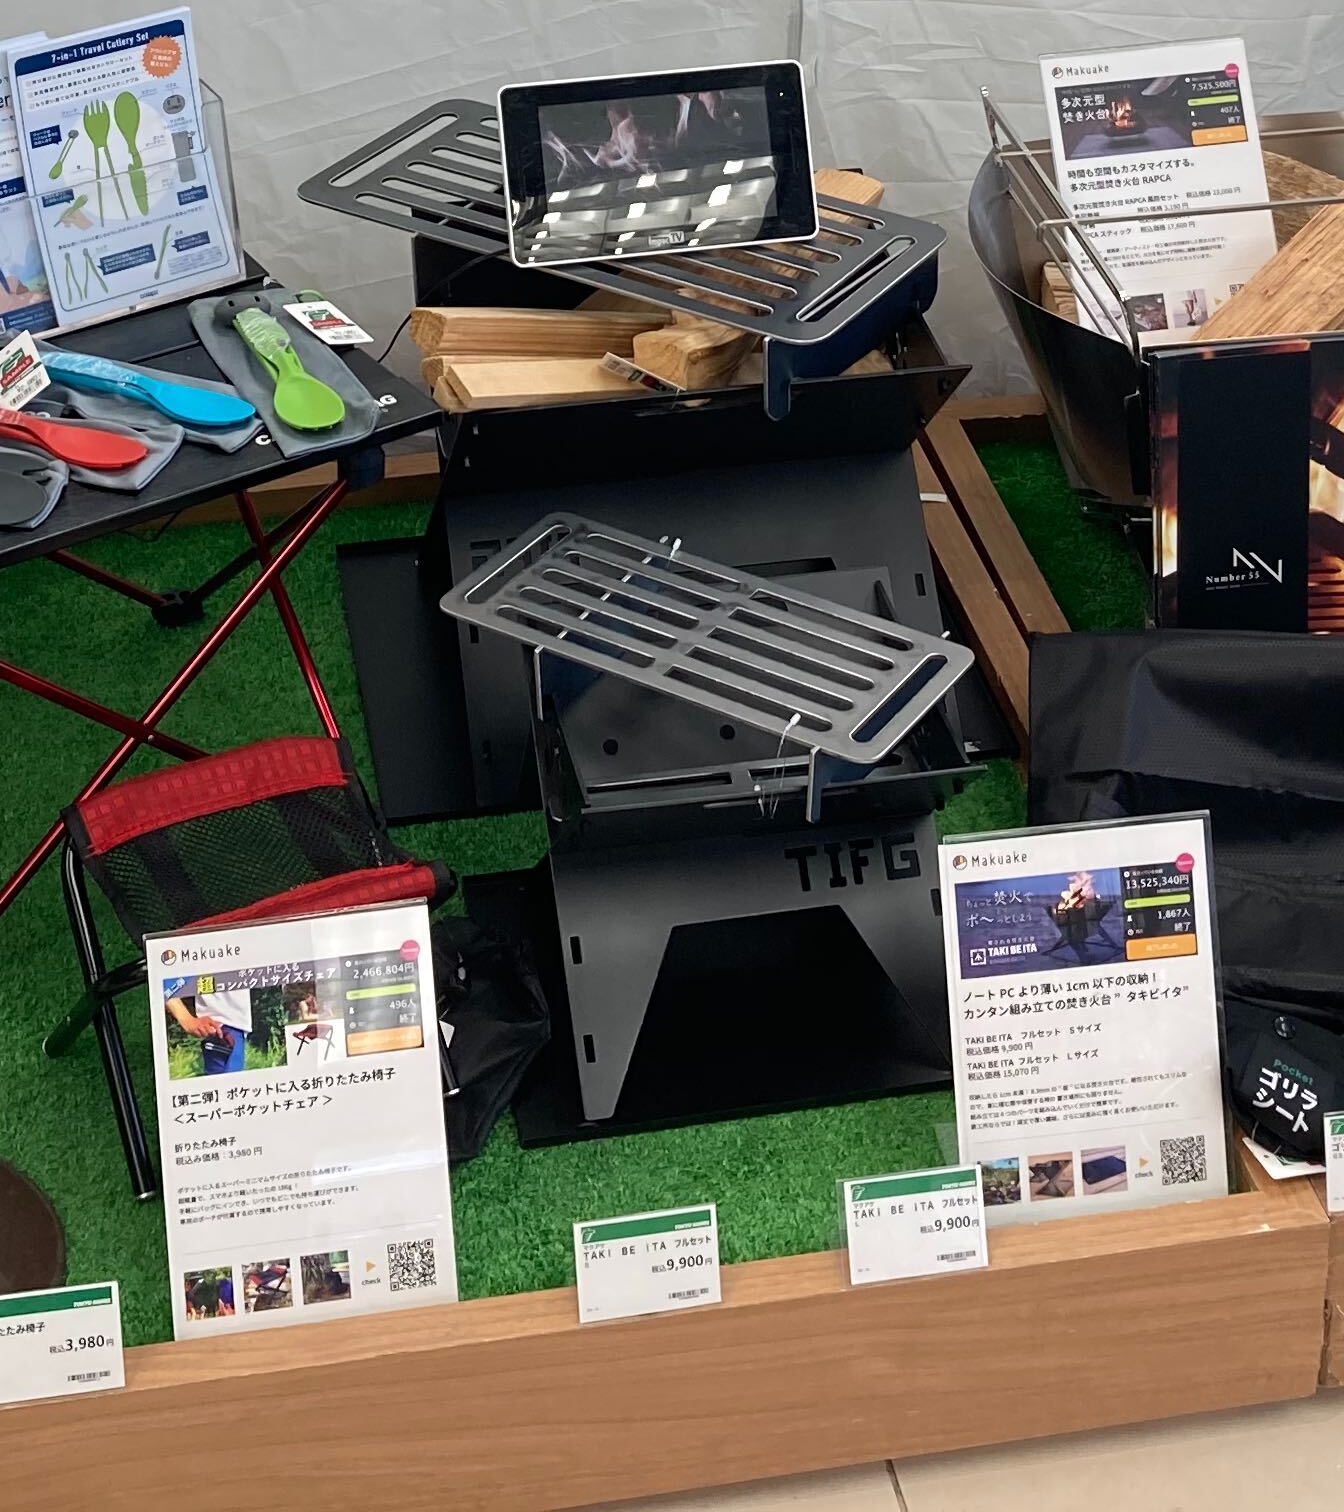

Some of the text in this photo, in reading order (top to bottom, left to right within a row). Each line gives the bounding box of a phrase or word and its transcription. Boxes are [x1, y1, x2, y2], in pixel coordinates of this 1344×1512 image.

[80, 43, 105, 57] Travel
[1066, 64, 1110, 76] Makuake
[1061, 94, 1106, 109] 多次元型
[1067, 159, 1195, 179] 時間も空間もカスタマイズする。
[1142, 174, 1172, 184] RAPCA
[1205, 574, 1246, 586] Number
[971, 851, 1028, 868] Makuake
[181, 944, 241, 962] Makuake
[988, 946, 1009, 957] TAKI
[353, 962, 415, 980] 2,466,804円
[389, 999, 416, 1010] 496人
[1273, 1058, 1314, 1086] Pocket
[1259, 1067, 1318, 1111] ゴリラ
[1252, 1088, 1309, 1133] シート
[942, 1195, 978, 1210] フルセット
[920, 1215, 980, 1235] 税込9,900円
[674, 1235, 712, 1249] フルセット
[651, 1254, 713, 1274] 税込9,900円
[49, 1335, 114, 1354] 税込3,980円
